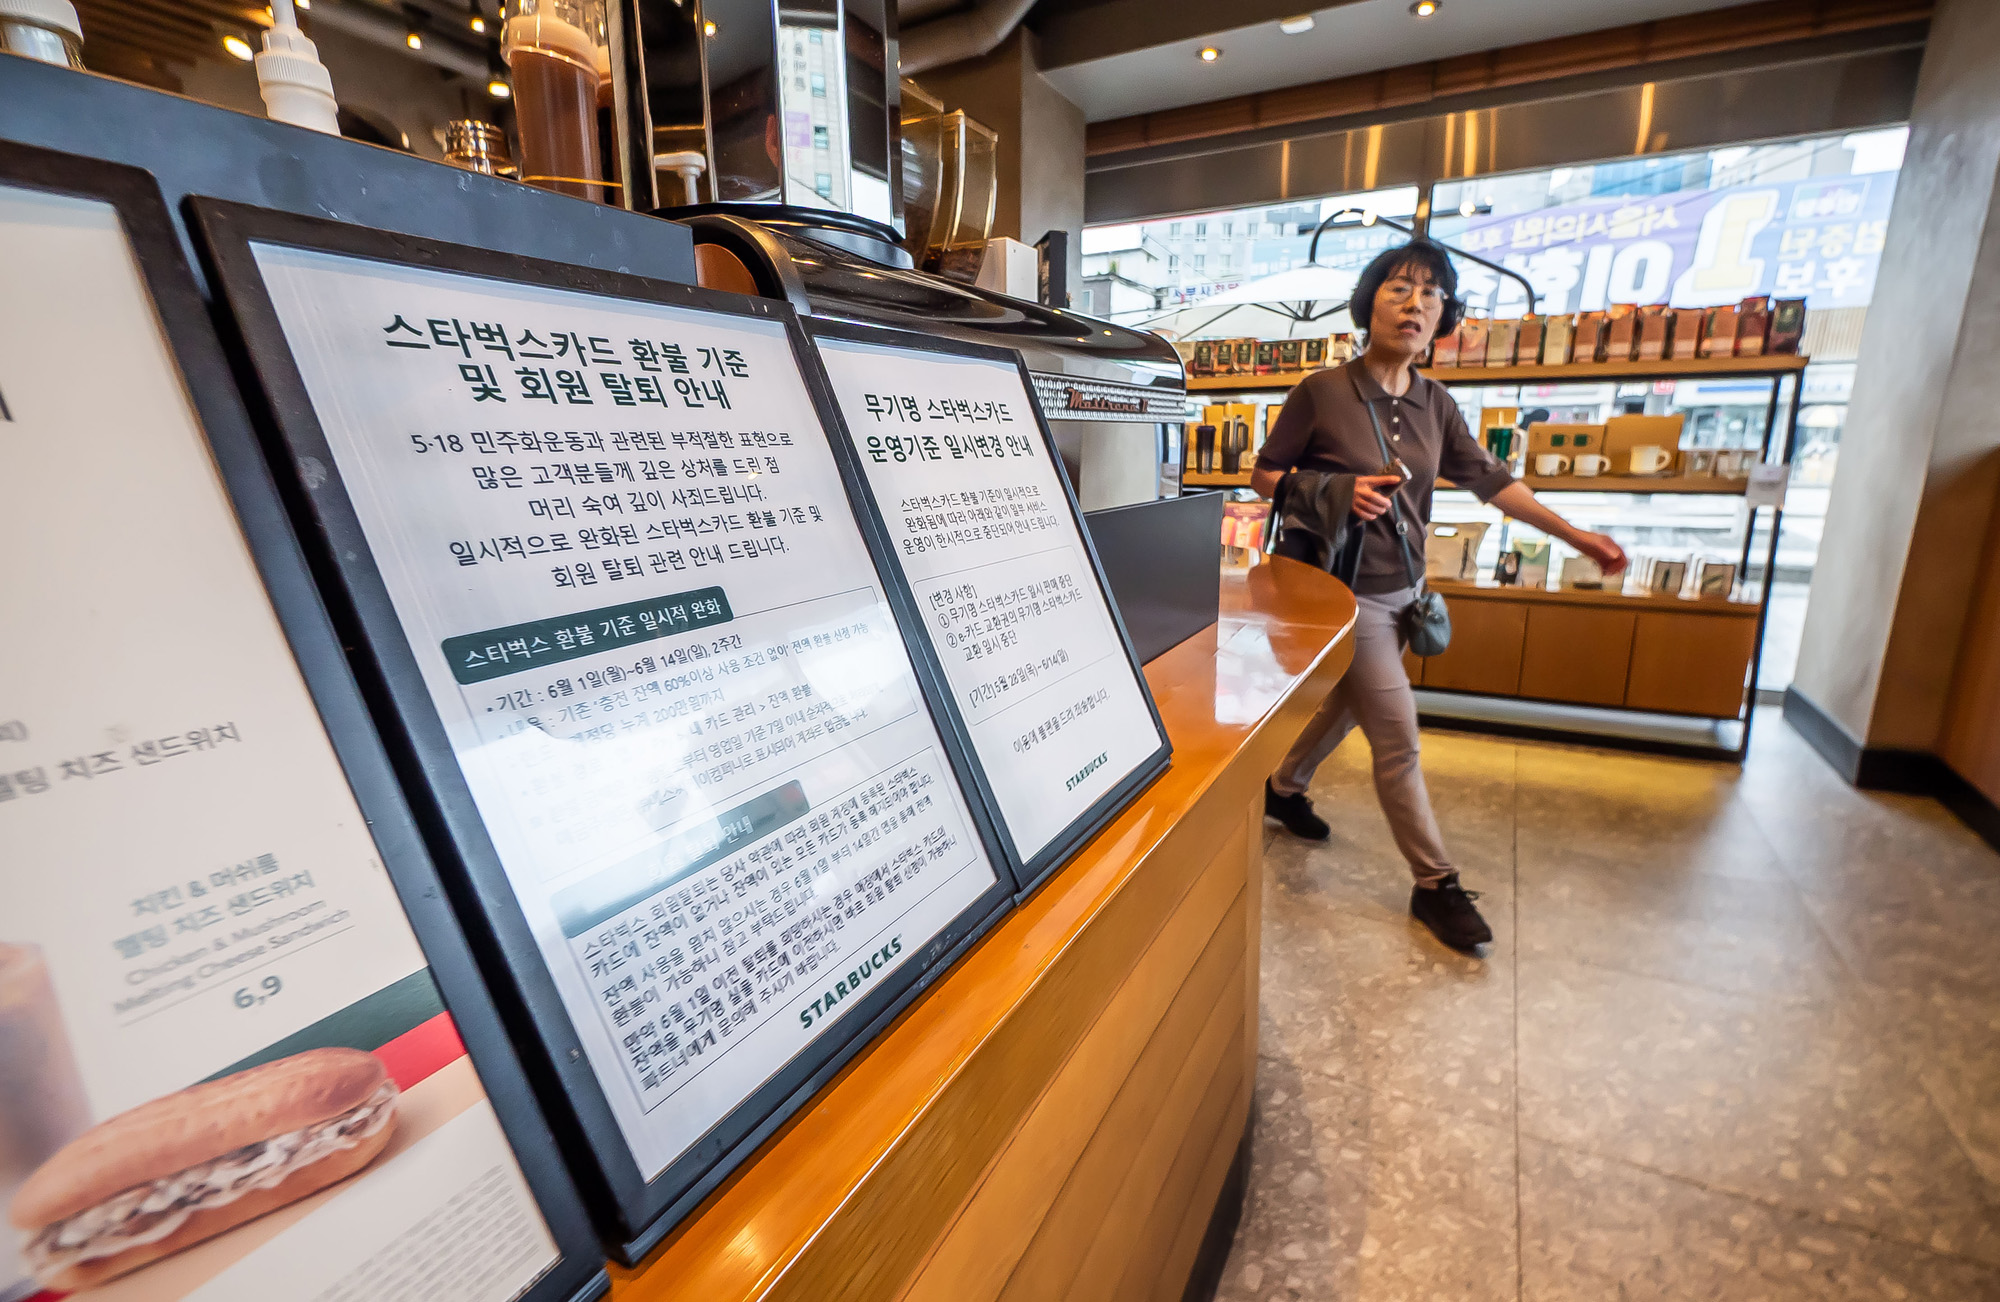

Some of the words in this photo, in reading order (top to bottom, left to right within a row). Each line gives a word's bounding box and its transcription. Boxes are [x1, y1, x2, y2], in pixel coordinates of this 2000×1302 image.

[383, 314, 622, 367] 스타벅스카드
[632, 338, 689, 375] 환불
[697, 346, 749, 378] 기준
[460, 362, 506, 403] 및
[515, 367, 594, 406] 회원
[600, 373, 668, 408] 탈퇴
[673, 378, 731, 410] 안내
[864, 393, 922, 422] 무기명
[927, 398, 1013, 424] 스타벅스카드
[471, 430, 605, 453] 민주화운동과
[611, 431, 665, 451] 관련된
[671, 431, 734, 450] 부적절한
[740, 431, 794, 448] 표현으로
[867, 435, 942, 463] 운영기준
[944, 434, 1004, 459] 일시변경
[1005, 434, 1034, 456] 안내
[473, 464, 523, 489] 많은
[533, 463, 634, 486] 고객분들께
[642, 461, 676, 480] 깊은
[680, 458, 728, 478] 상처를
[734, 457, 763, 474] 드린
[766, 456, 780, 474] 점
[528, 497, 575, 521] 머리
[581, 494, 622, 515] 숙여
[629, 489, 665, 512] 깊이
[672, 484, 767, 508] 사죄드립니다.
[901, 494, 961, 513] 스타벅스카드
[960, 490, 979, 506] 환불
[980, 487, 1004, 503] 기준이
[1004, 485, 1041, 501] 일시적으로
[905, 513, 948, 534] 완화됨에
[948, 511, 968, 525] 따라
[967, 506, 993, 522] 아래와
[993, 503, 1010, 518] 같이
[1010, 503, 1025, 518] 일부
[1026, 501, 1048, 515] 서비스
[449, 532, 573, 567] 일시적으로
[578, 524, 638, 551] 완화된
[645, 514, 744, 543] 스타벅스카드
[748, 510, 777, 529] 환불
[780, 507, 806, 525] 기준
[809, 506, 823, 523] 및
[902, 535, 937, 555] 운영이
[935, 527, 983, 549] 한시적으로
[982, 521, 1015, 539] 중단되어
[1014, 518, 1031, 534] 안내
[551, 563, 598, 589] 회원
[602, 556, 644, 580] 탈퇴
[651, 551, 684, 575] 관련
[689, 545, 725, 567] 안내
[729, 536, 791, 560] 드립니다.
[950, 603, 979, 623] 무기명
[979, 587, 1029, 614] 스타벅스카드
[1028, 583, 1043, 599] 일시
[464, 638, 551, 668] 스타벅스
[554, 624, 595, 650] 환불
[599, 614, 636, 638] 기준
[639, 604, 689, 631] 일시적
[691, 598, 722, 620] 완화
[496, 689, 534, 711] 기간
[548, 678, 575, 699] 6월
[712, 634, 743, 654] 2주간
[559, 702, 592, 724] 기존
[633, 681, 663, 702] 잔액
[664, 664, 714, 691] 60%이상
[717, 657, 741, 676] 사용
[742, 652, 765, 669] 조건
[705, 710, 731, 732] 카드
[57, 751, 126, 780] 치즈
[131, 721, 242, 766] 샌드위치
[1065, 752, 1108, 792] STARBUCKS
[800, 936, 901, 1029] STARBUCKS
